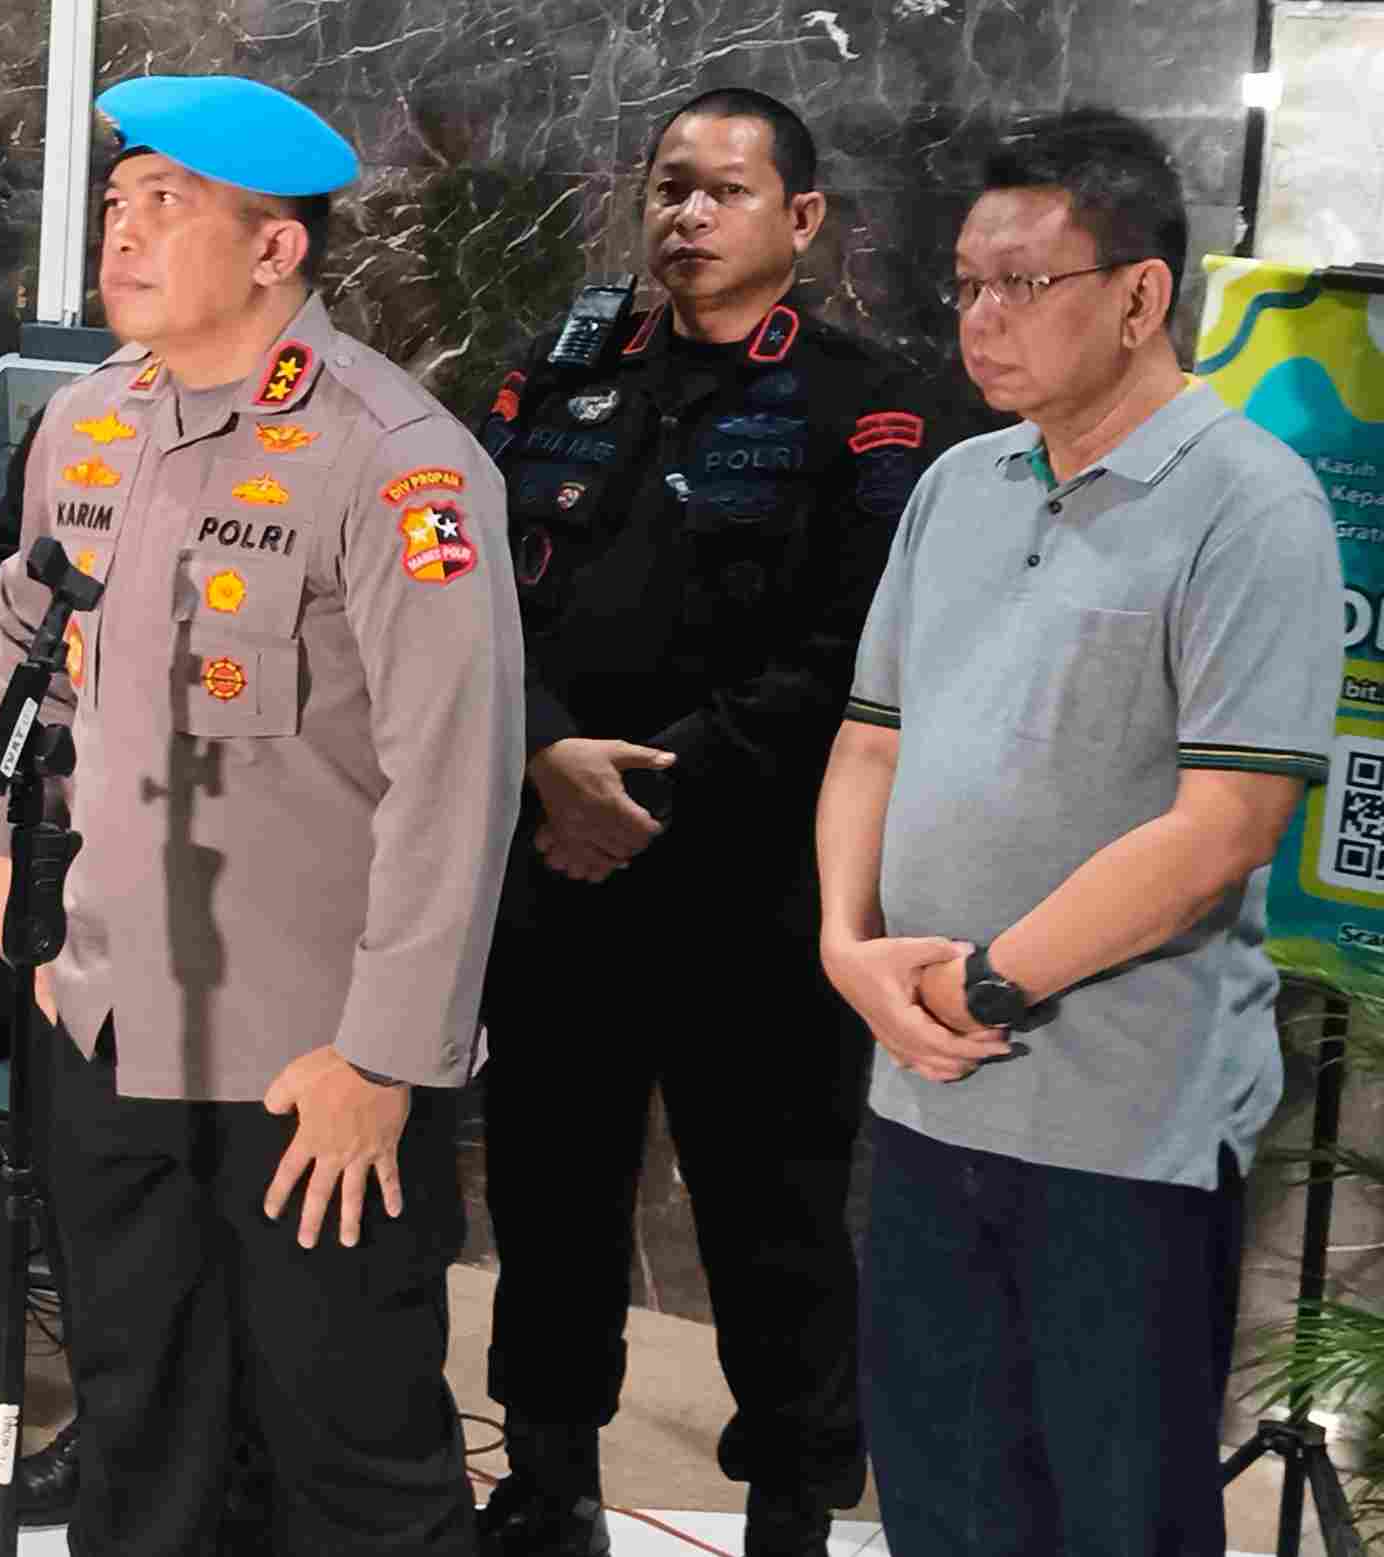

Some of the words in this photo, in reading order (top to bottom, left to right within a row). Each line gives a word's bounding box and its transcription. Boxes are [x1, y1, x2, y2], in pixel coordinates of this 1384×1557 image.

[705, 447, 803, 472] POLRI
[56, 501, 113, 531] KARIM
[198, 516, 297, 556] POLRI
